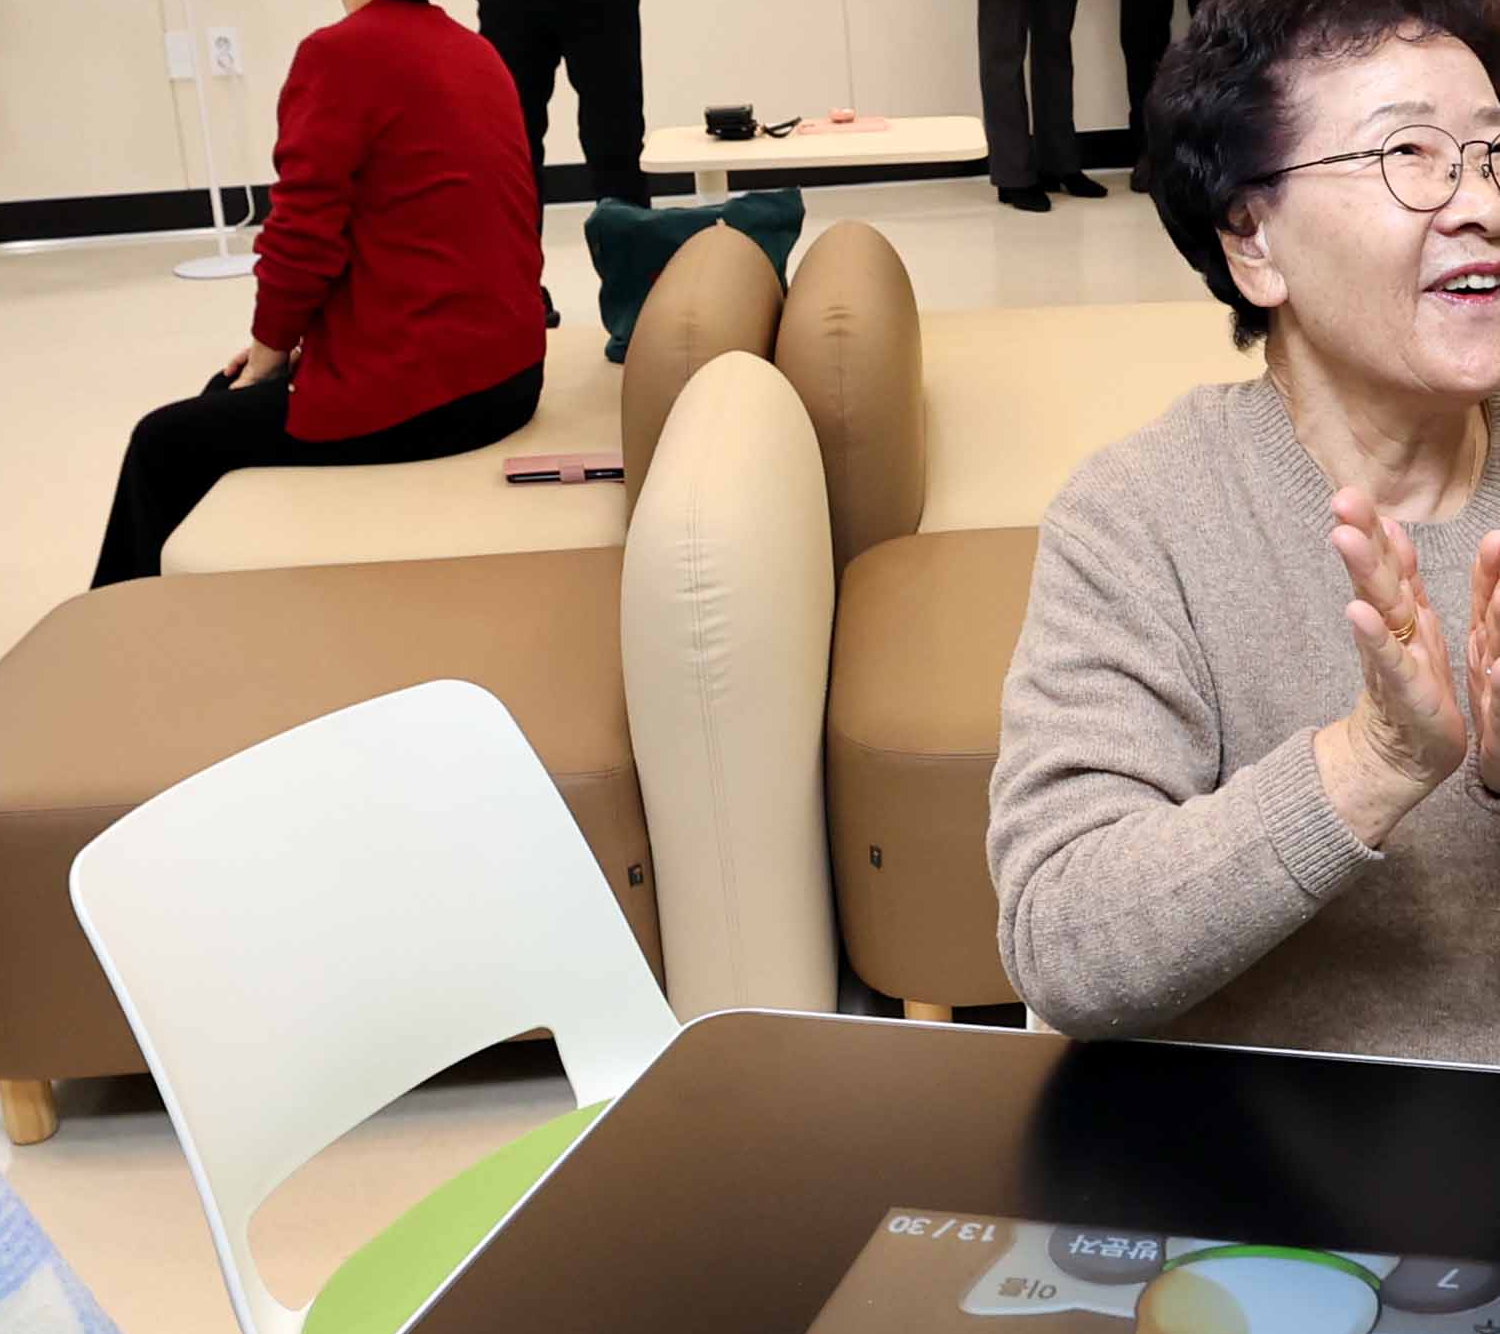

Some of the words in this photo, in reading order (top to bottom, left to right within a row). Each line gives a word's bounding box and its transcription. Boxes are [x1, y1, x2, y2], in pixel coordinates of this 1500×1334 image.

[888, 1215, 932, 1235] 30
[957, 1223, 997, 1243] 13
[1068, 1233, 1159, 1262] 방문자
[997, 1275, 1058, 1301] 이름
